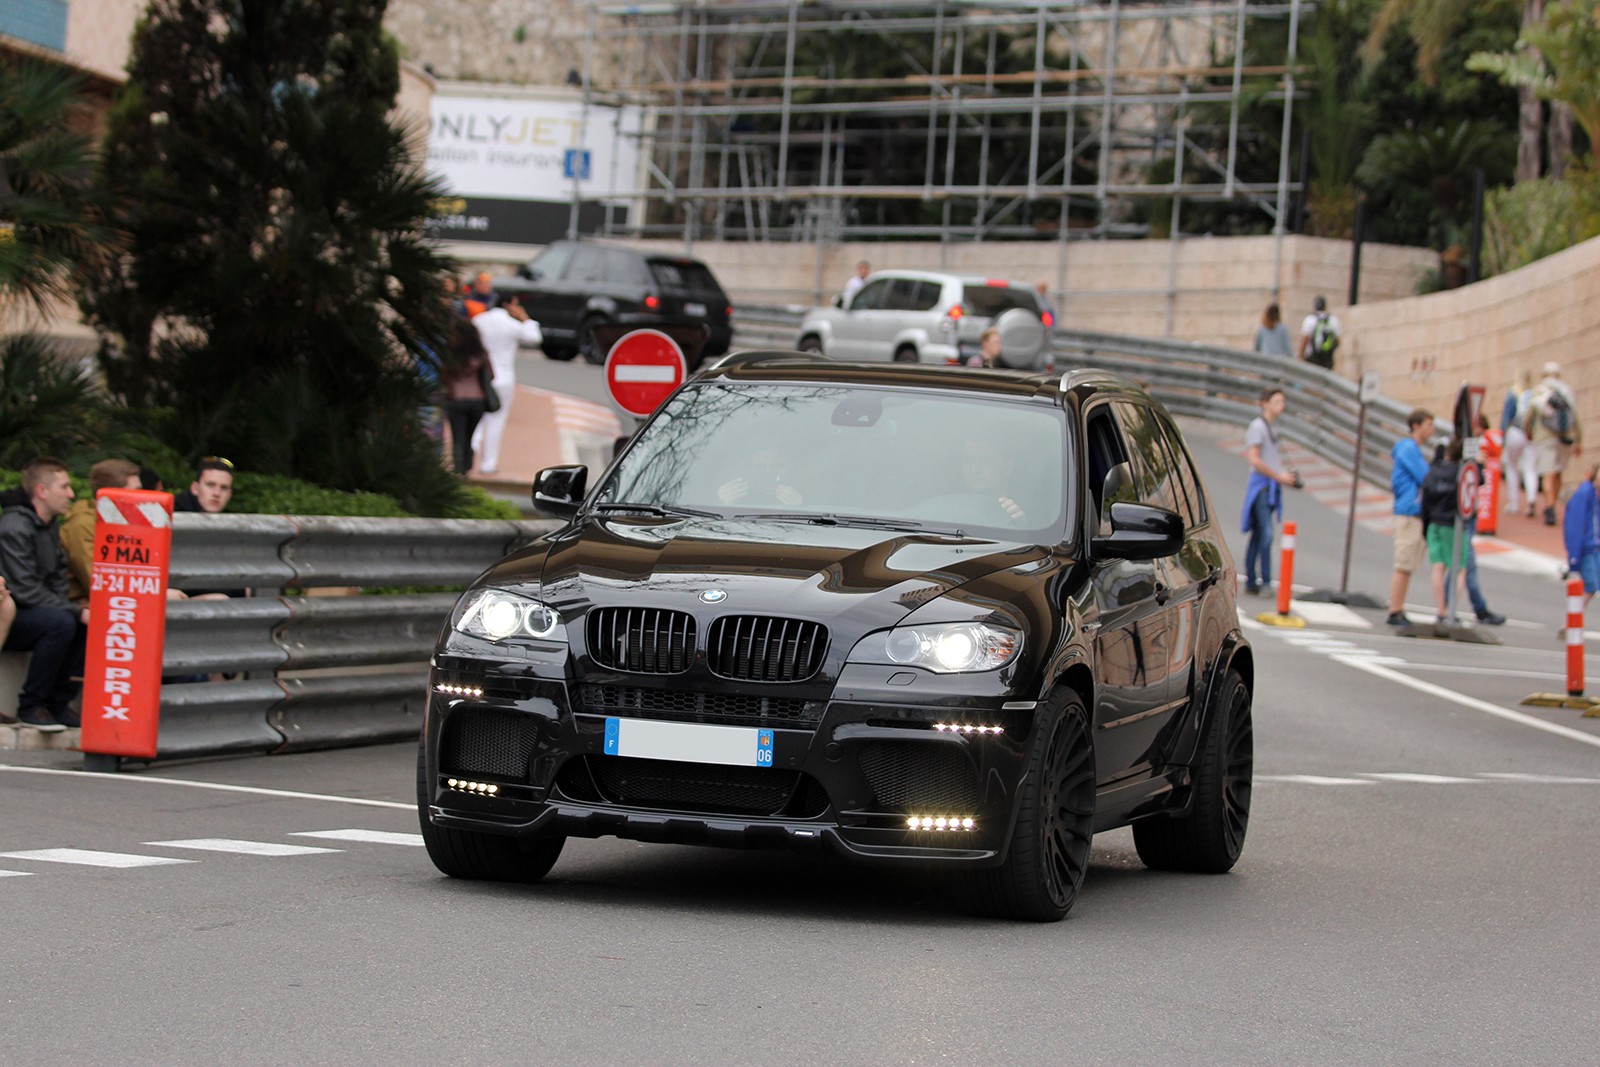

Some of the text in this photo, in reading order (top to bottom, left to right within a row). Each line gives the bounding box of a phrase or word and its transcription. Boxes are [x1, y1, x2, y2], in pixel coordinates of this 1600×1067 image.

[428, 114, 586, 147] NLYJET
[101, 545, 150, 564] 9 MAI
[91, 573, 161, 596] 21-24 MAI
[101, 595, 138, 721] GRAND PRIX
[608, 739, 615, 748] F
[758, 749, 772, 763] 06
